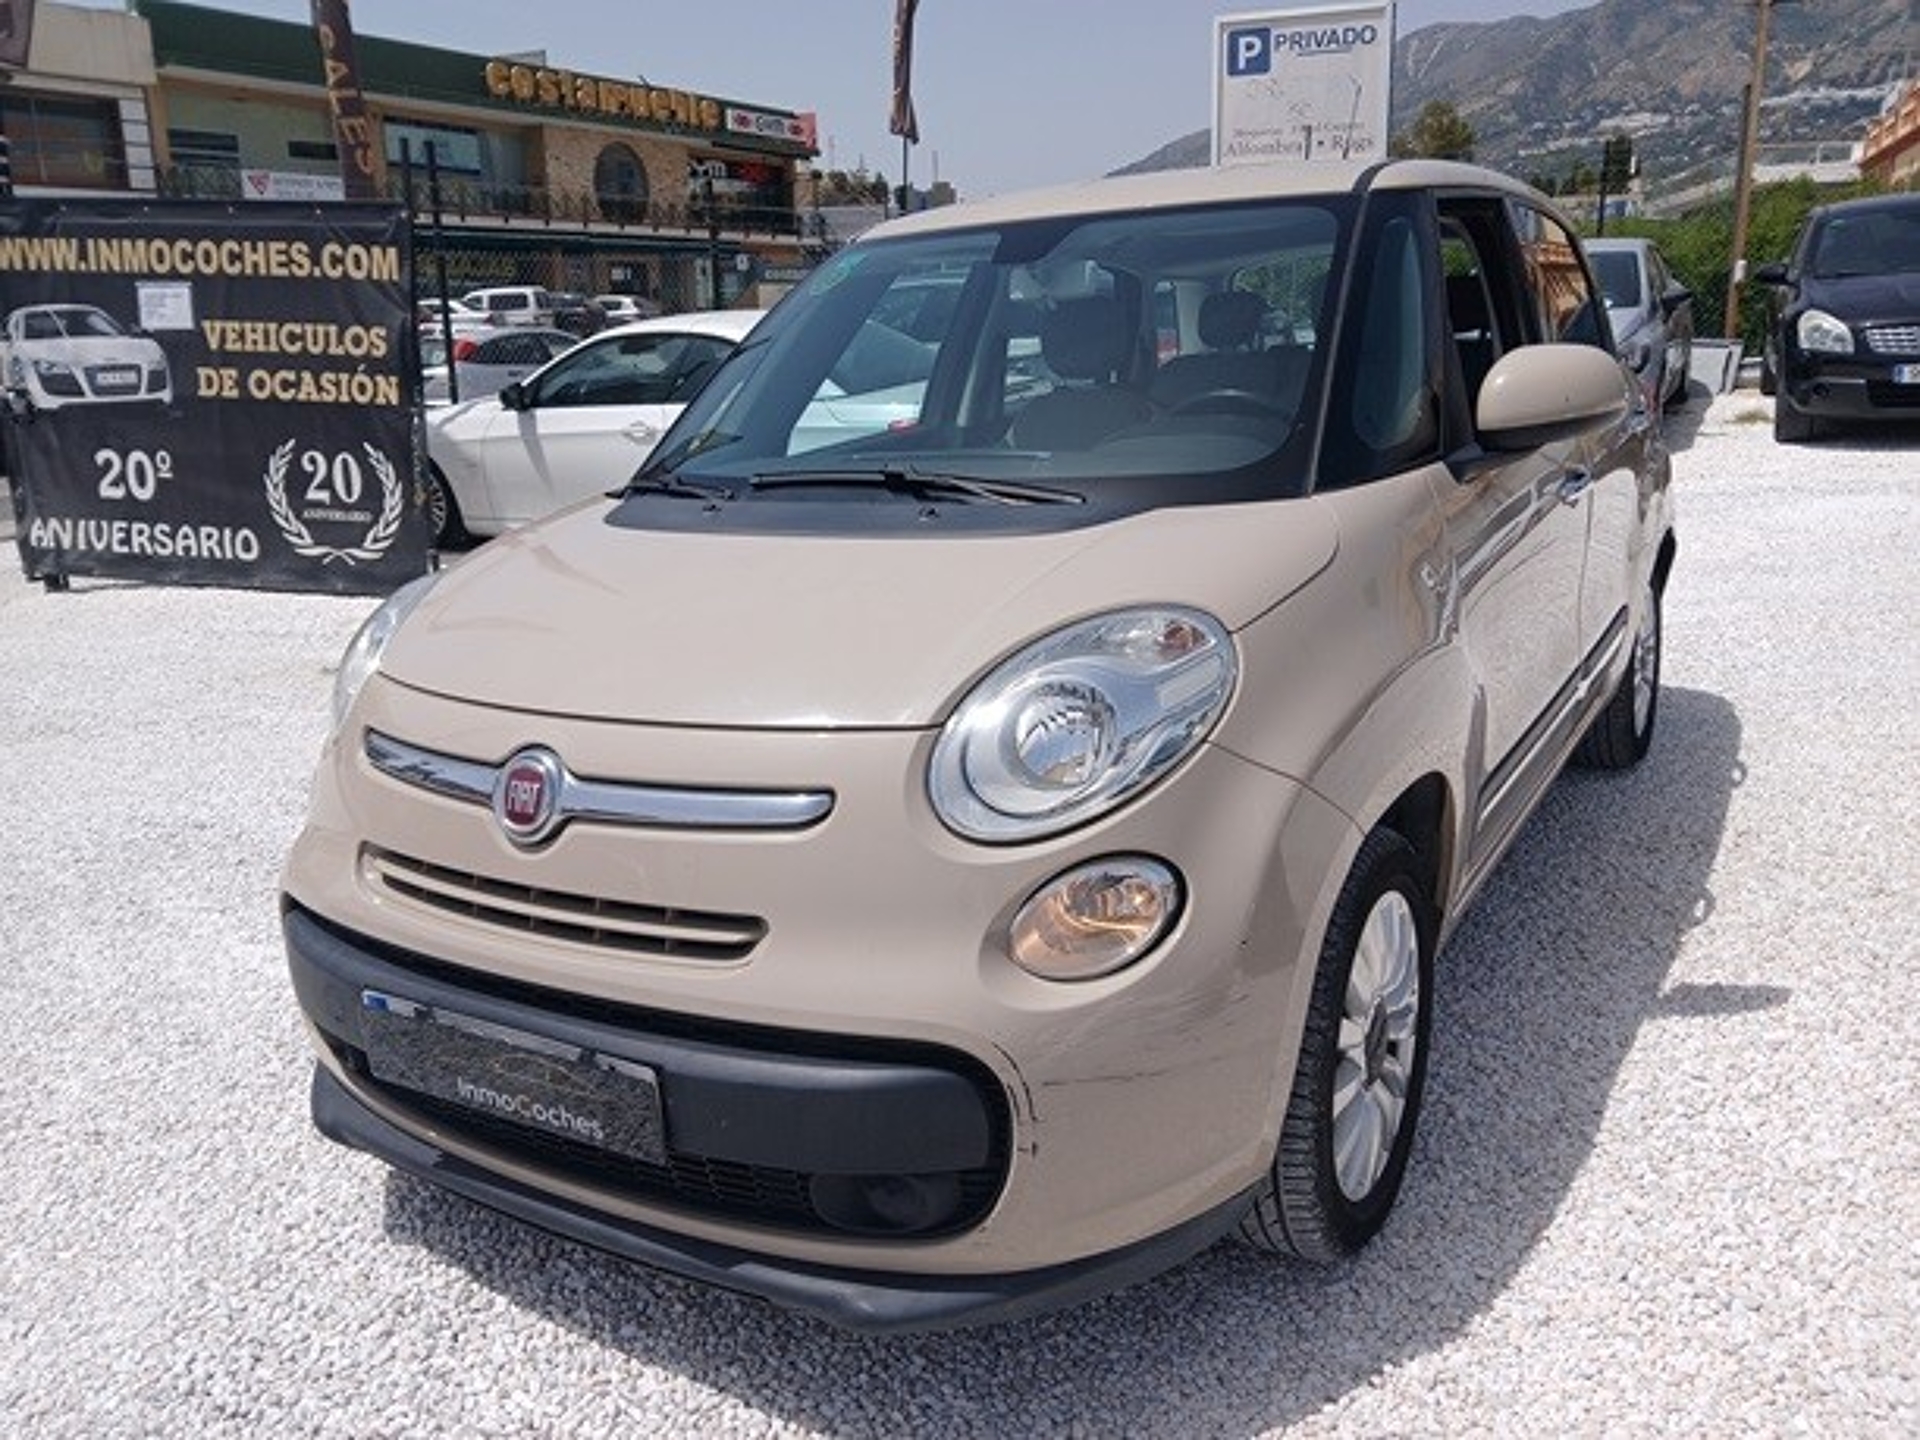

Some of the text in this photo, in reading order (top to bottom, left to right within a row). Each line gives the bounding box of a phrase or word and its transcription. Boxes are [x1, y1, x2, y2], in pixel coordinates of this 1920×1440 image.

[1238, 25, 1378, 70] P PRIVADO
[0, 236, 400, 282] WWW.INMOCOCHES.COM
[202, 320, 388, 357] VEHICULOS
[198, 365, 399, 406] DE OCASIÓN
[301, 450, 362, 505] 20
[29, 516, 260, 562] ANIVERSARIO
[508, 781, 541, 813] FIAT
